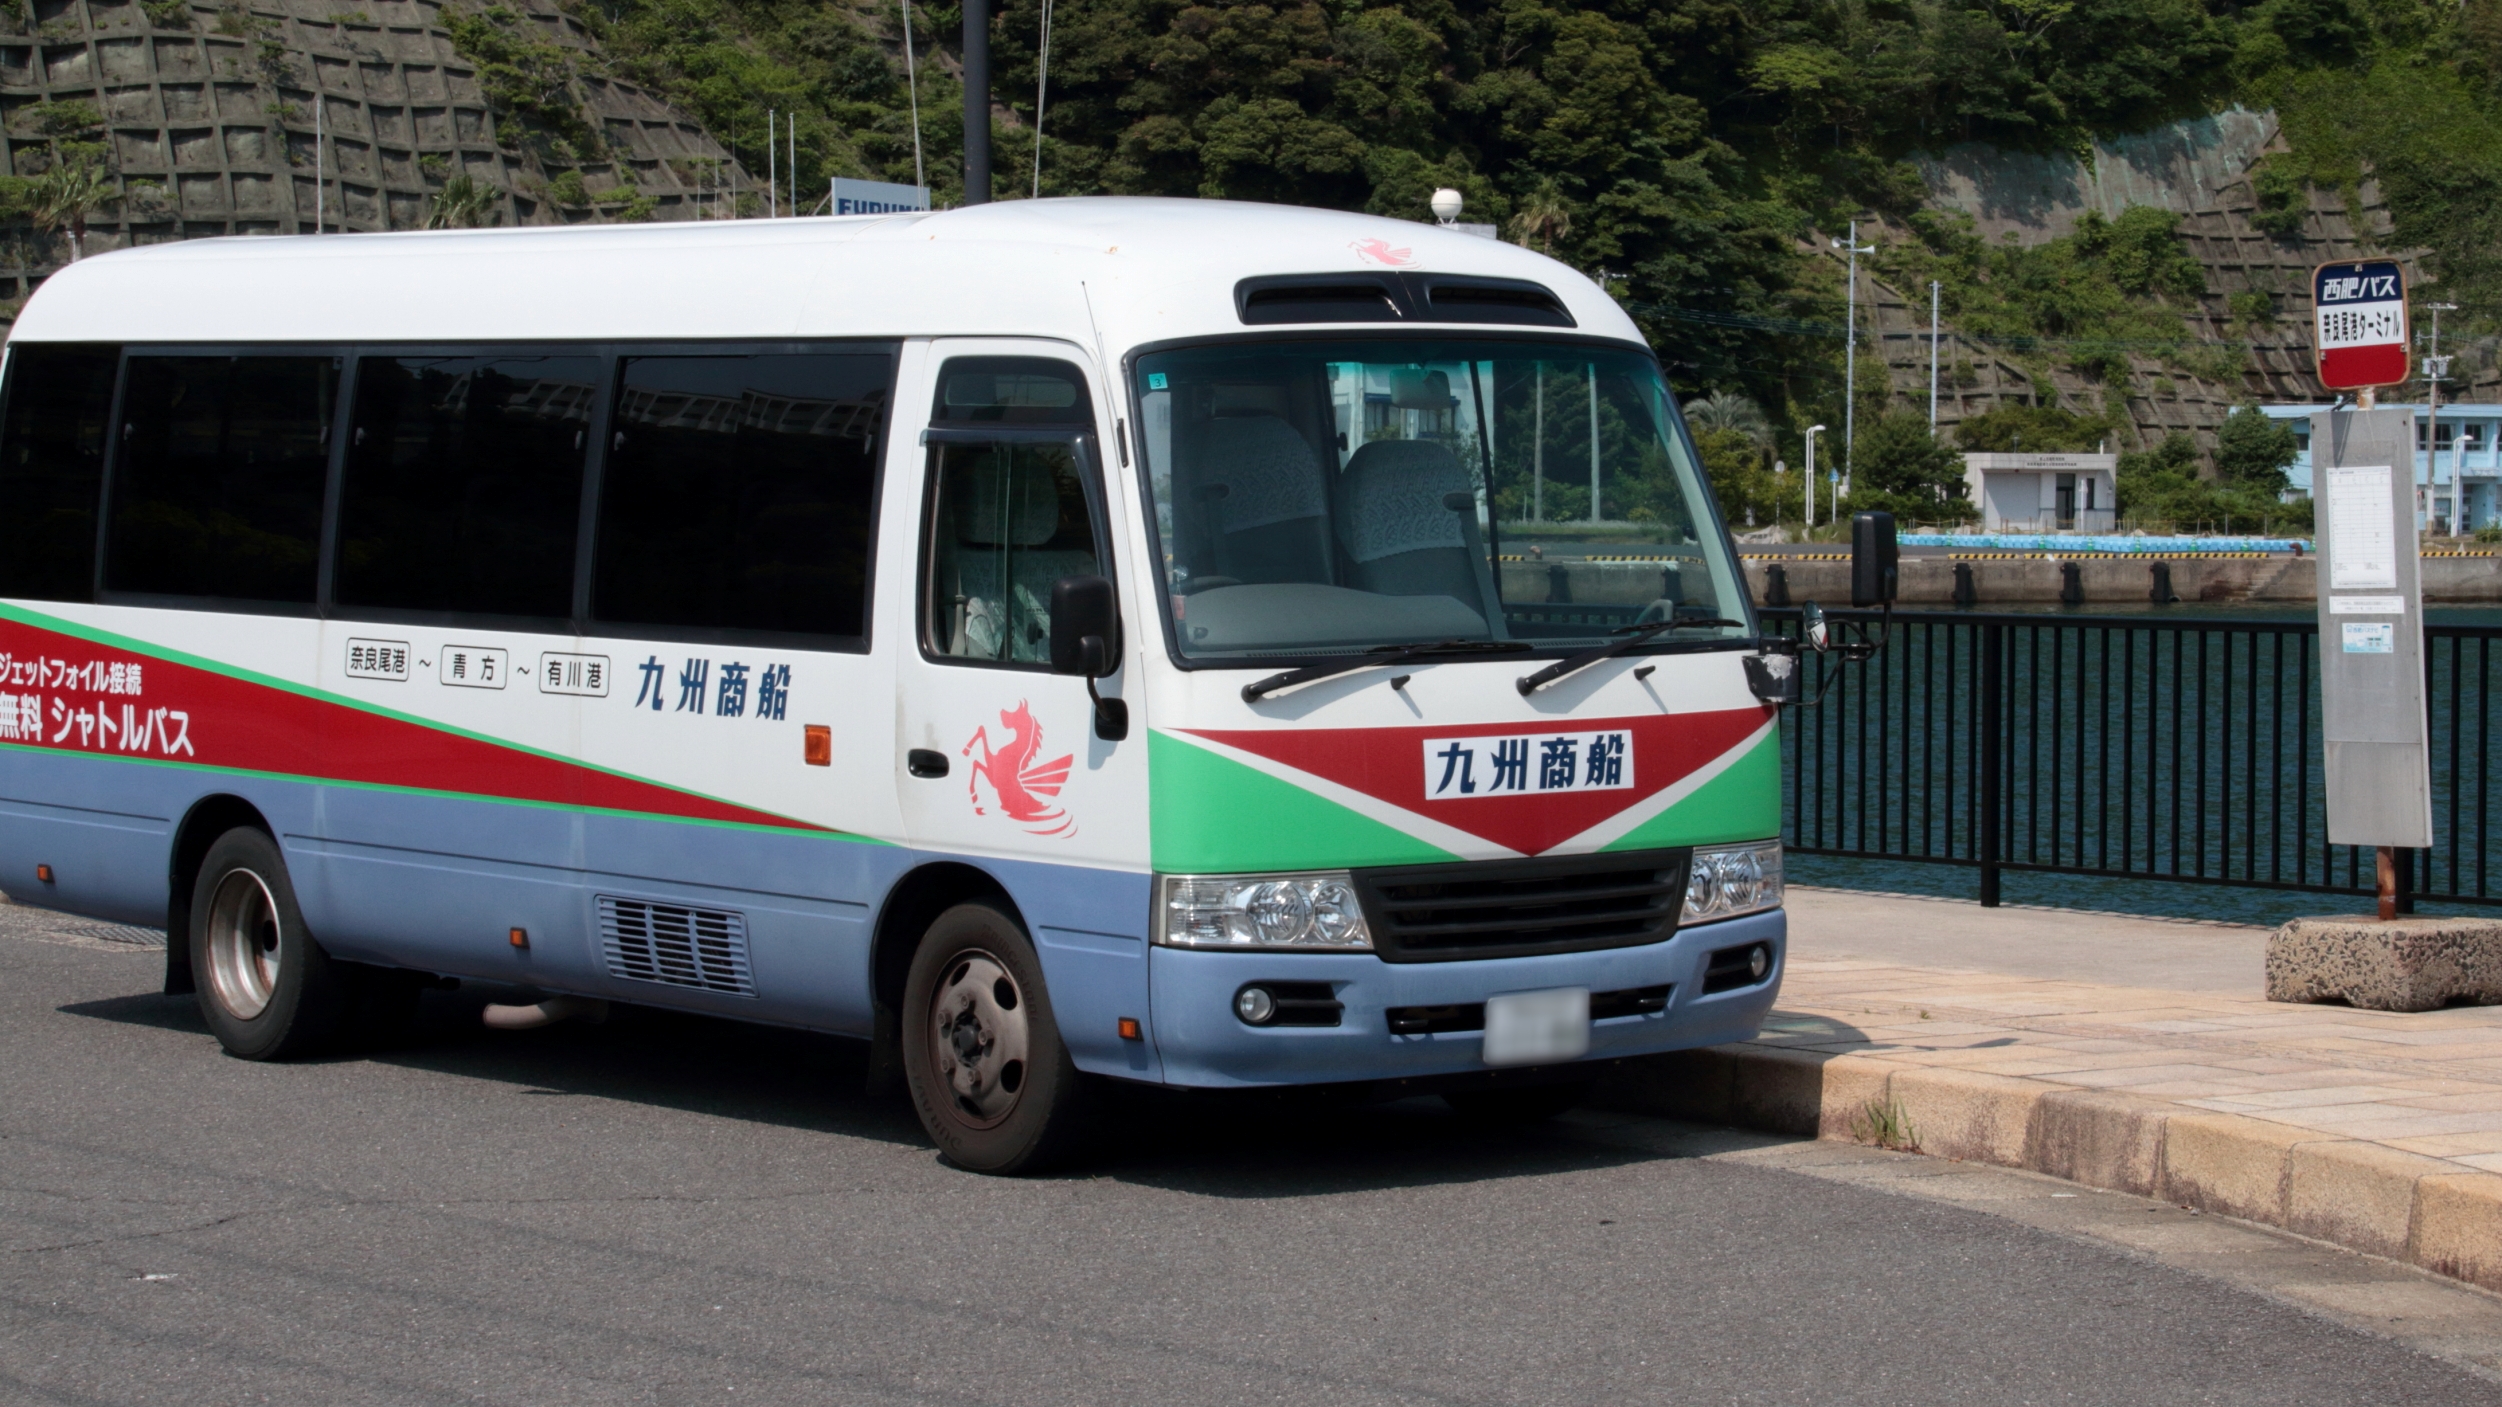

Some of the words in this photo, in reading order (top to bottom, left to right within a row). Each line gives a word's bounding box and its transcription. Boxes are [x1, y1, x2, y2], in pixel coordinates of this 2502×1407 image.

[838, 198, 925, 215] FURU
[2323, 275, 2396, 301] 西肥バス
[2323, 310, 2400, 342] 奈良尾港ターミナル
[0, 652, 142, 696] ジェットフォイル接続
[350, 645, 406, 674] 奈良尾港
[547, 660, 602, 689] 有川港
[635, 655, 792, 721] 九州商船
[51, 697, 194, 757] シャトルバス
[1435, 734, 1625, 795] 九州商船
